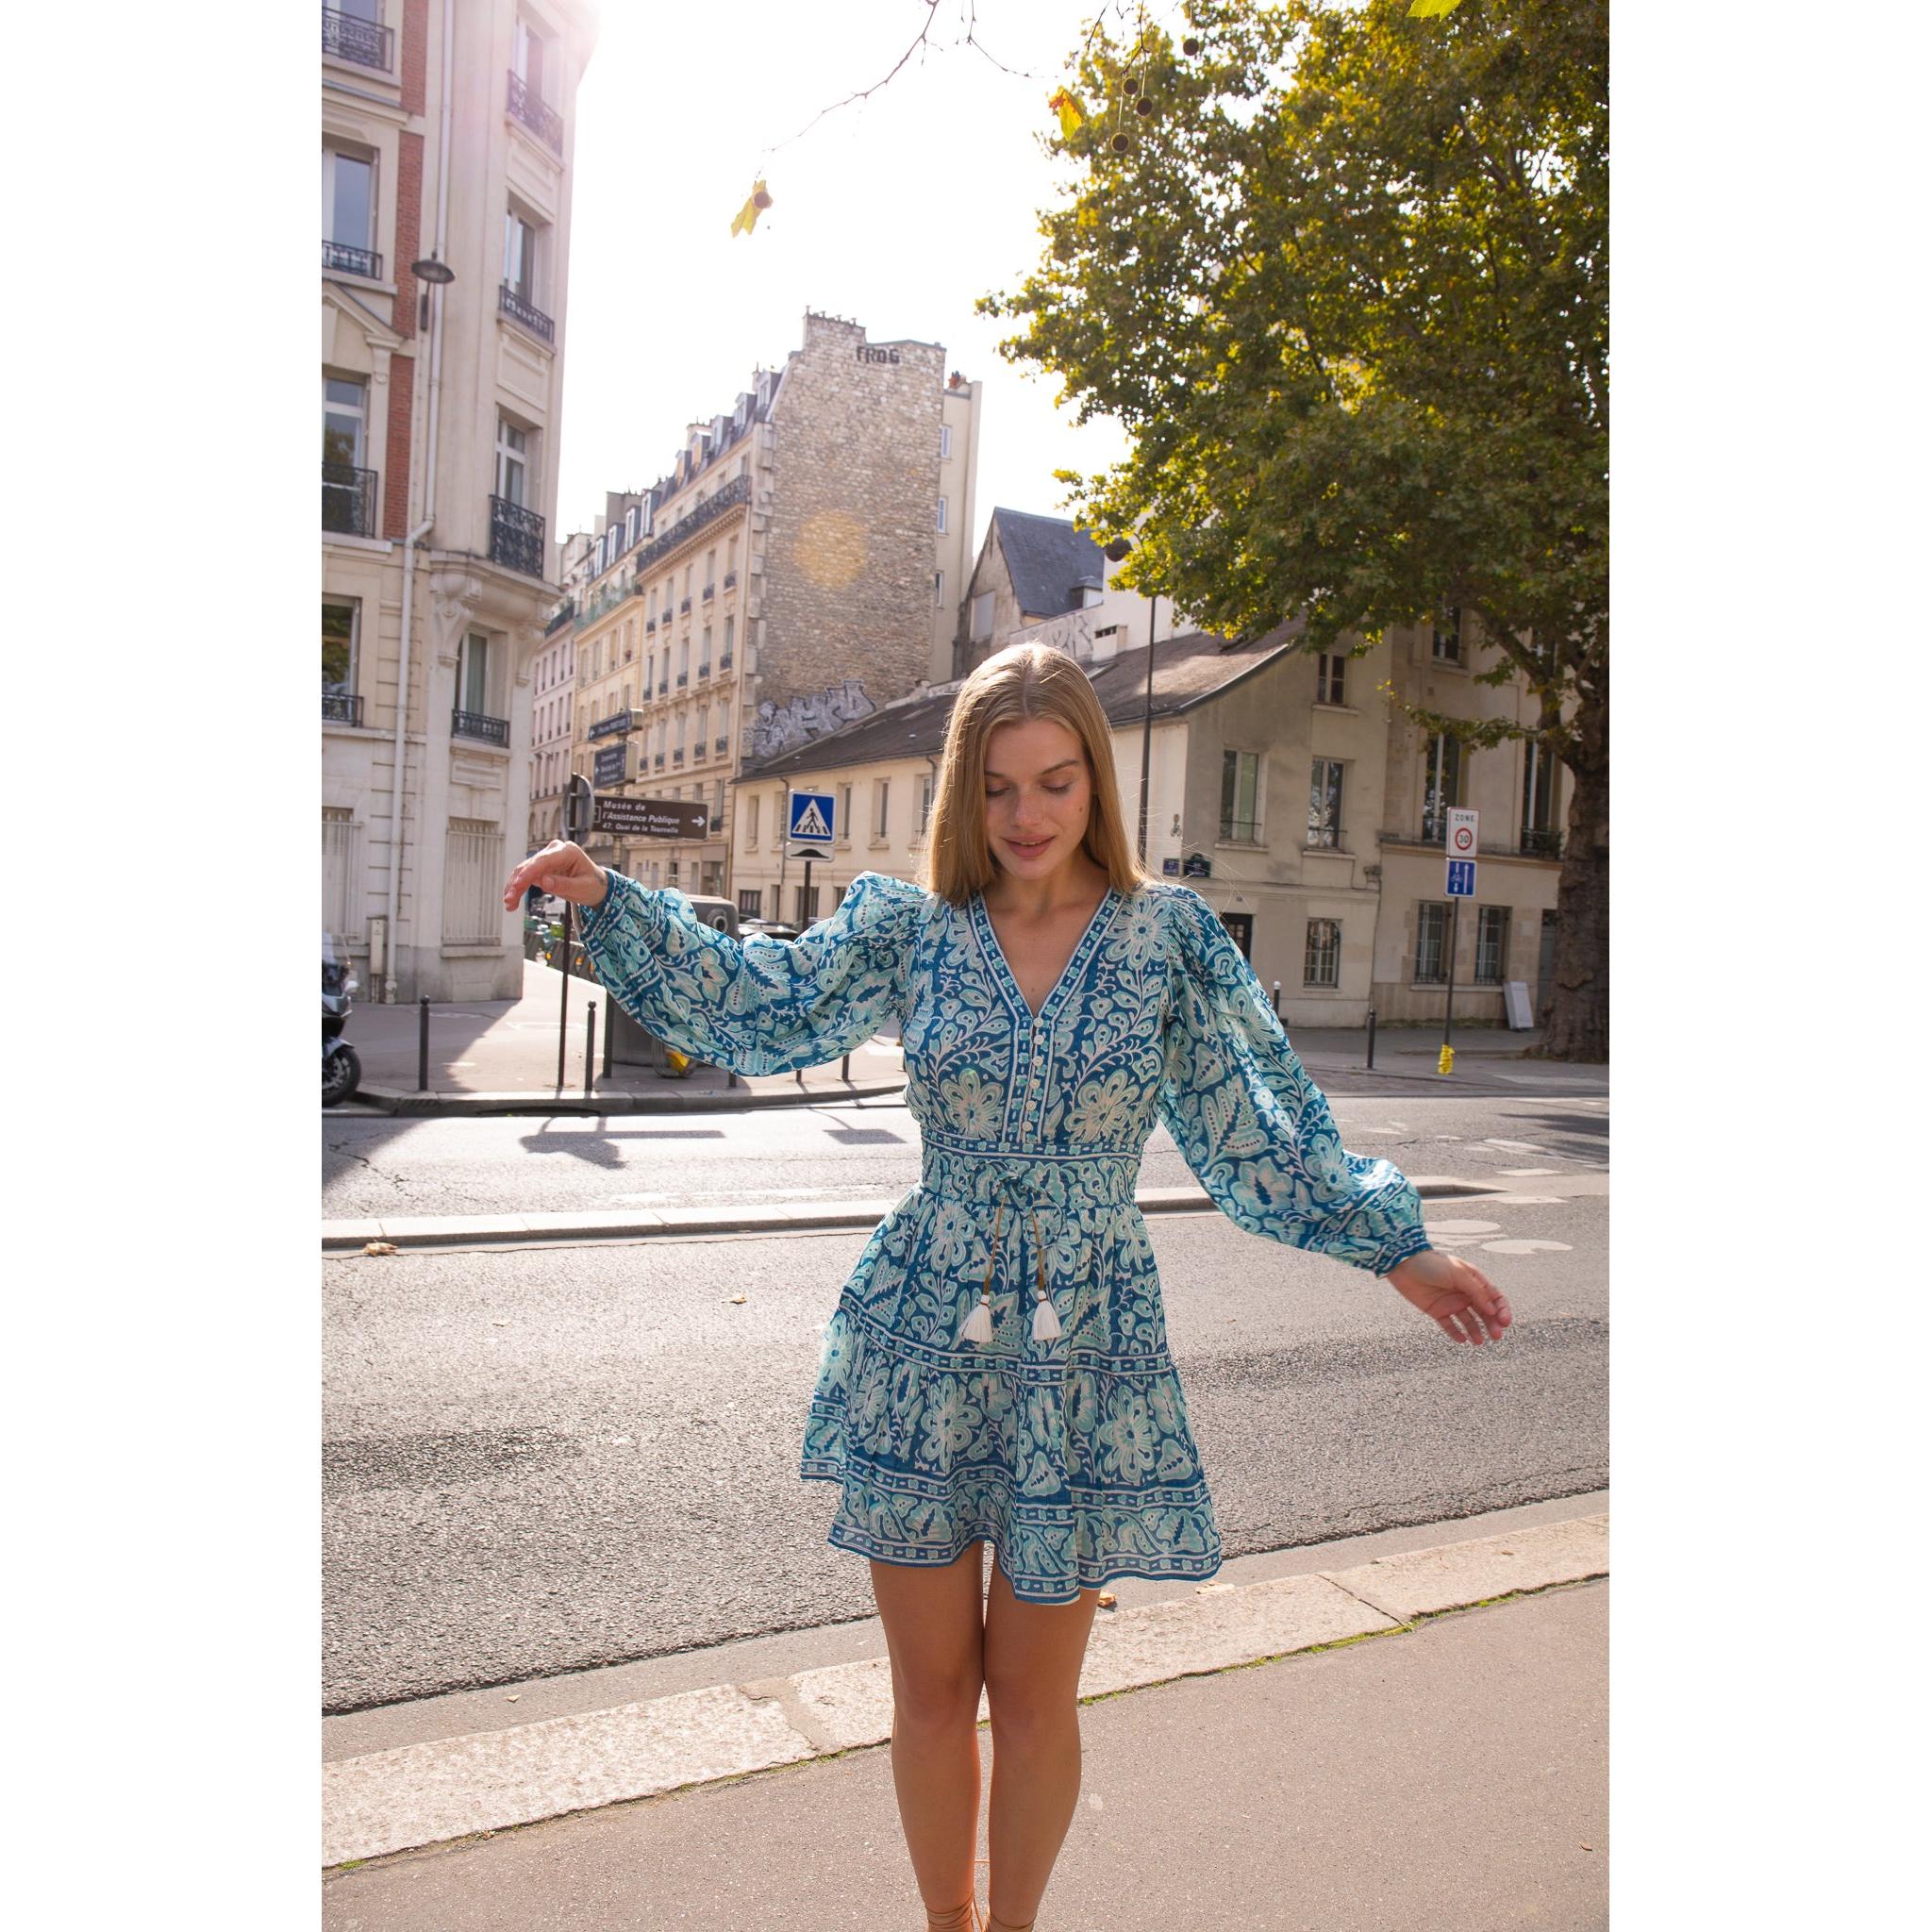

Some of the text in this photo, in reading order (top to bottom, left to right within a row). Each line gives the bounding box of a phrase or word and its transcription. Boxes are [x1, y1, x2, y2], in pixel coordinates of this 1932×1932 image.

[857, 345, 900, 364] FROG
[603, 800, 646, 811] Musée de
[602, 811, 680, 825] l'Assistance Publique
[1456, 814, 1474, 824] ZONE
[615, 823, 631, 831] Quai
[1459, 834, 1469, 843] 30
